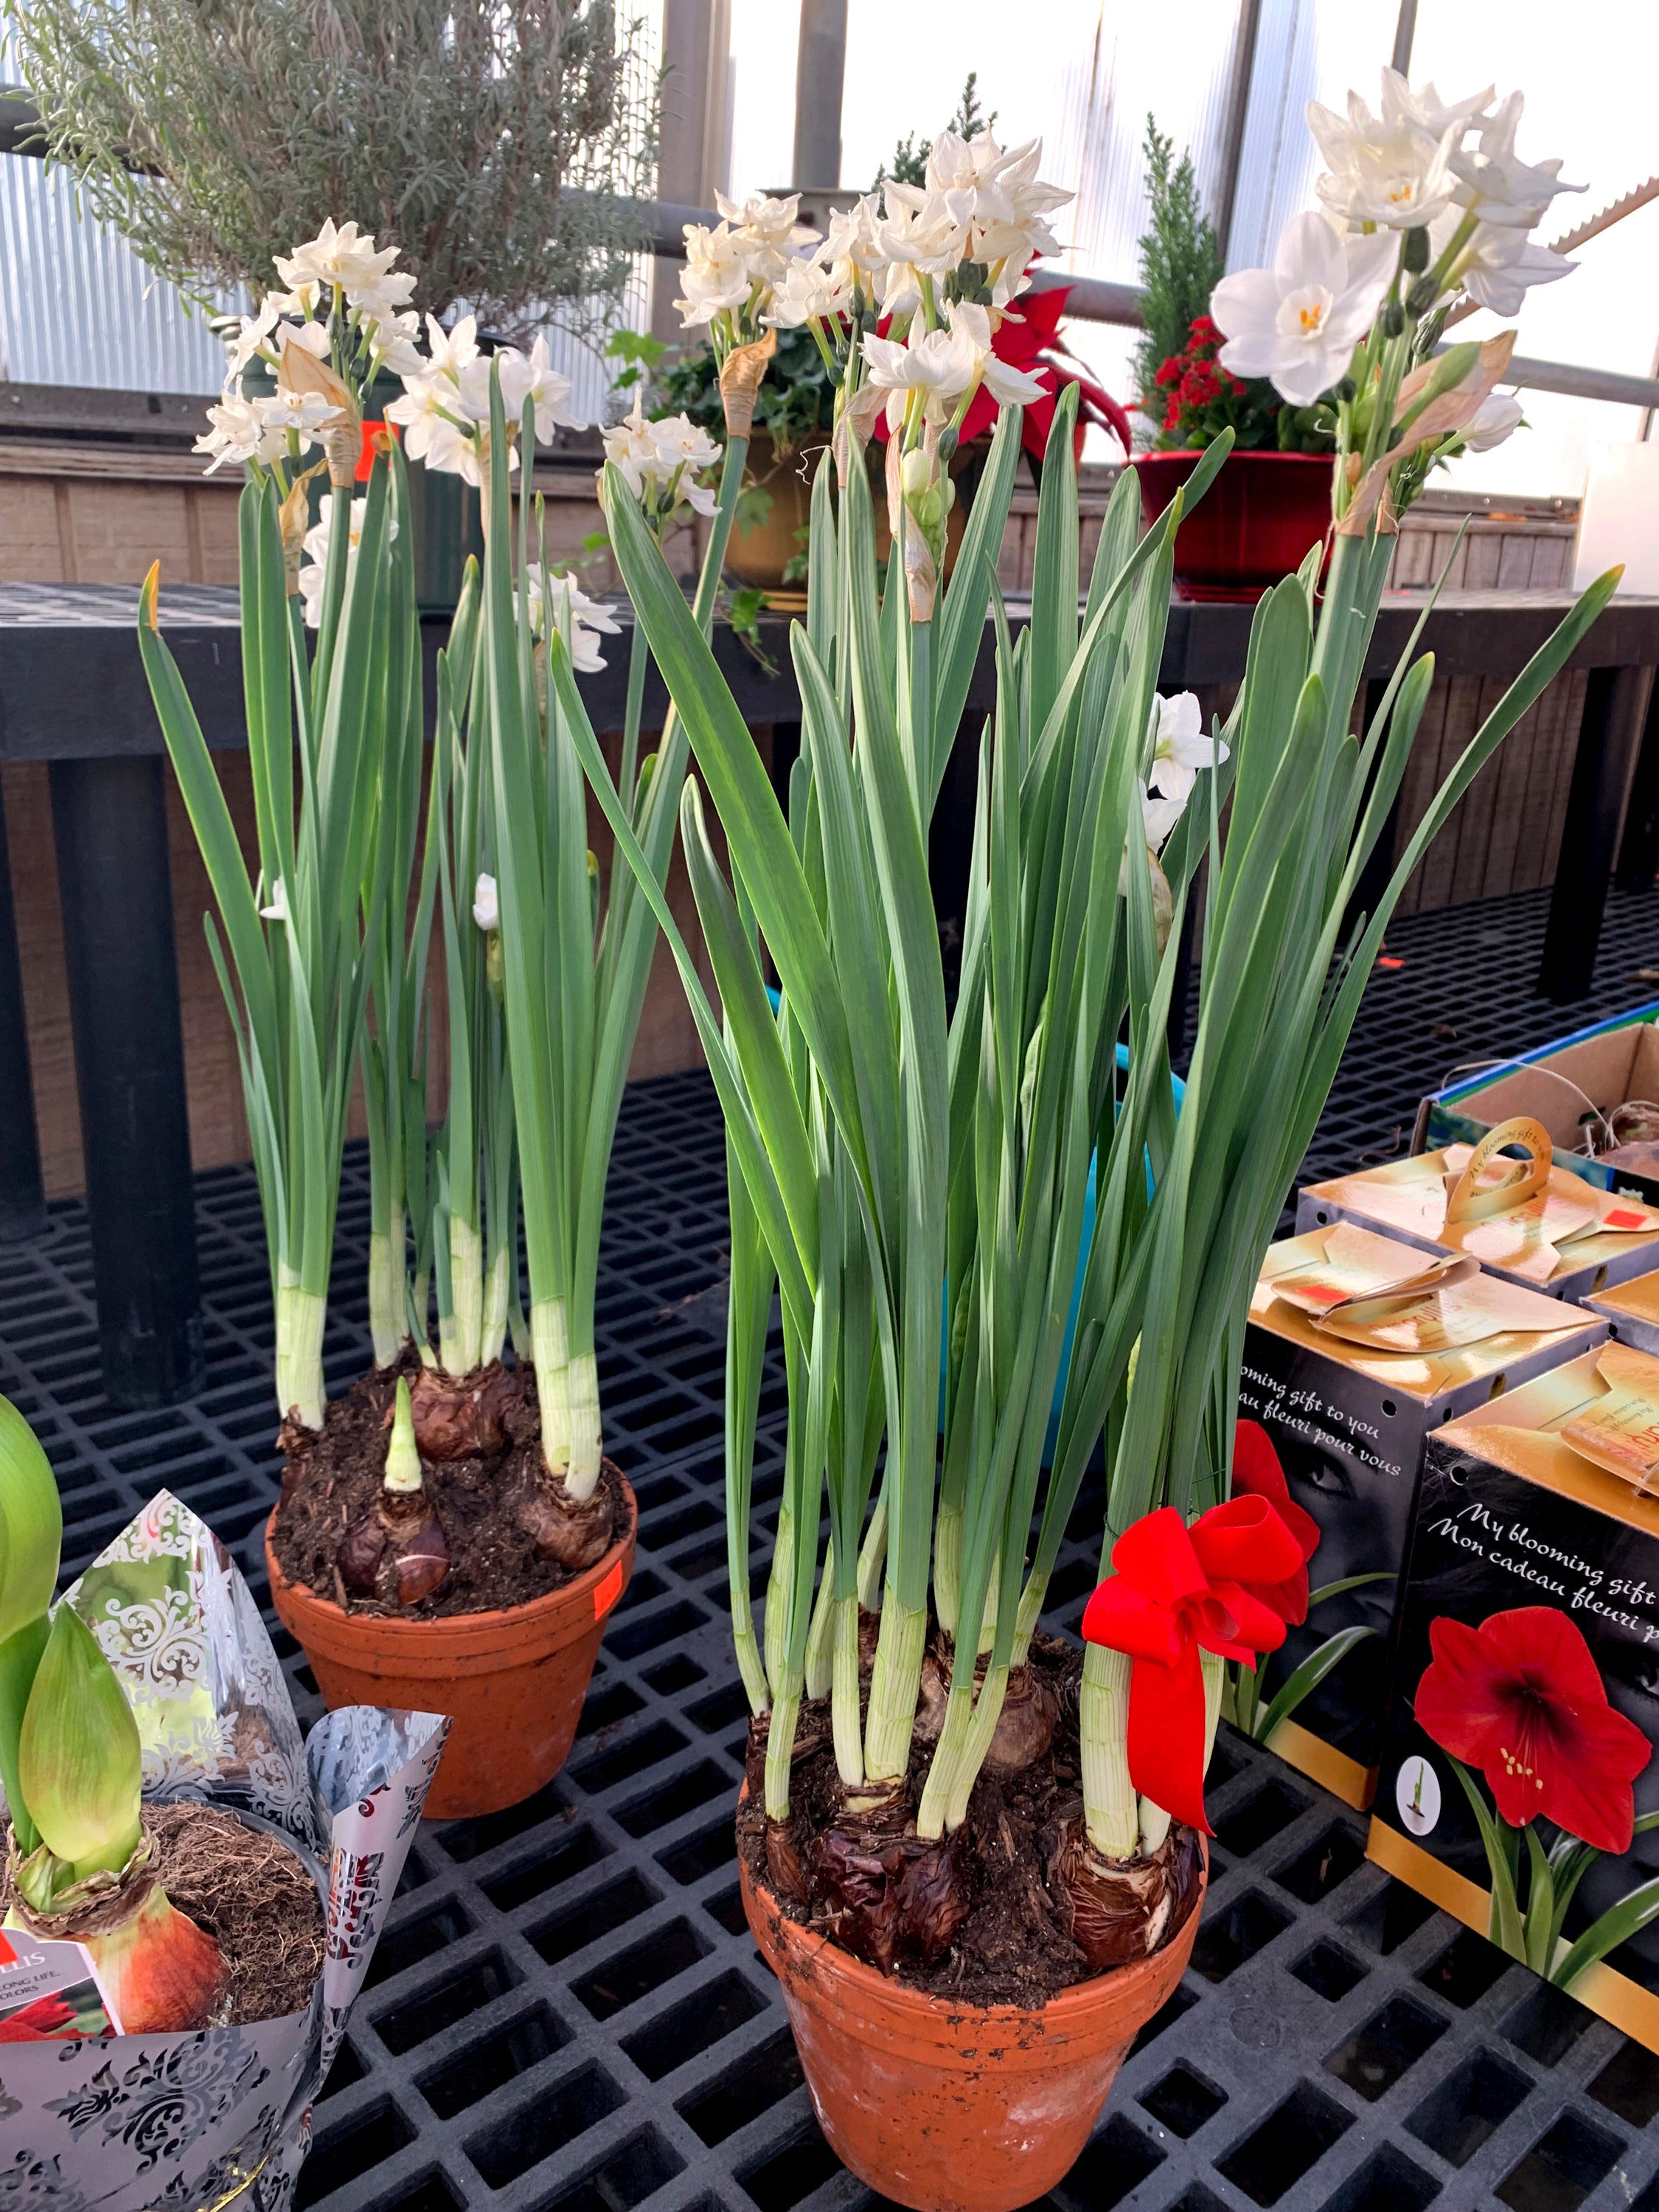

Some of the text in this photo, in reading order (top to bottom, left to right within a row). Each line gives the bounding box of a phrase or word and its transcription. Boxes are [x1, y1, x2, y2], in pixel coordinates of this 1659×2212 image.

[1240, 1366, 1379, 1439] oming gift to you
[1262, 1399, 1310, 1434] fleuri
[1313, 1428, 1354, 1455] pour
[1360, 1450, 1401, 1476] vous
[1427, 1518, 1638, 1630] Mon cadeau fleuri
[1456, 1503, 1657, 1604] My blooming gift
[0, 1951, 46, 1974] LLIS
